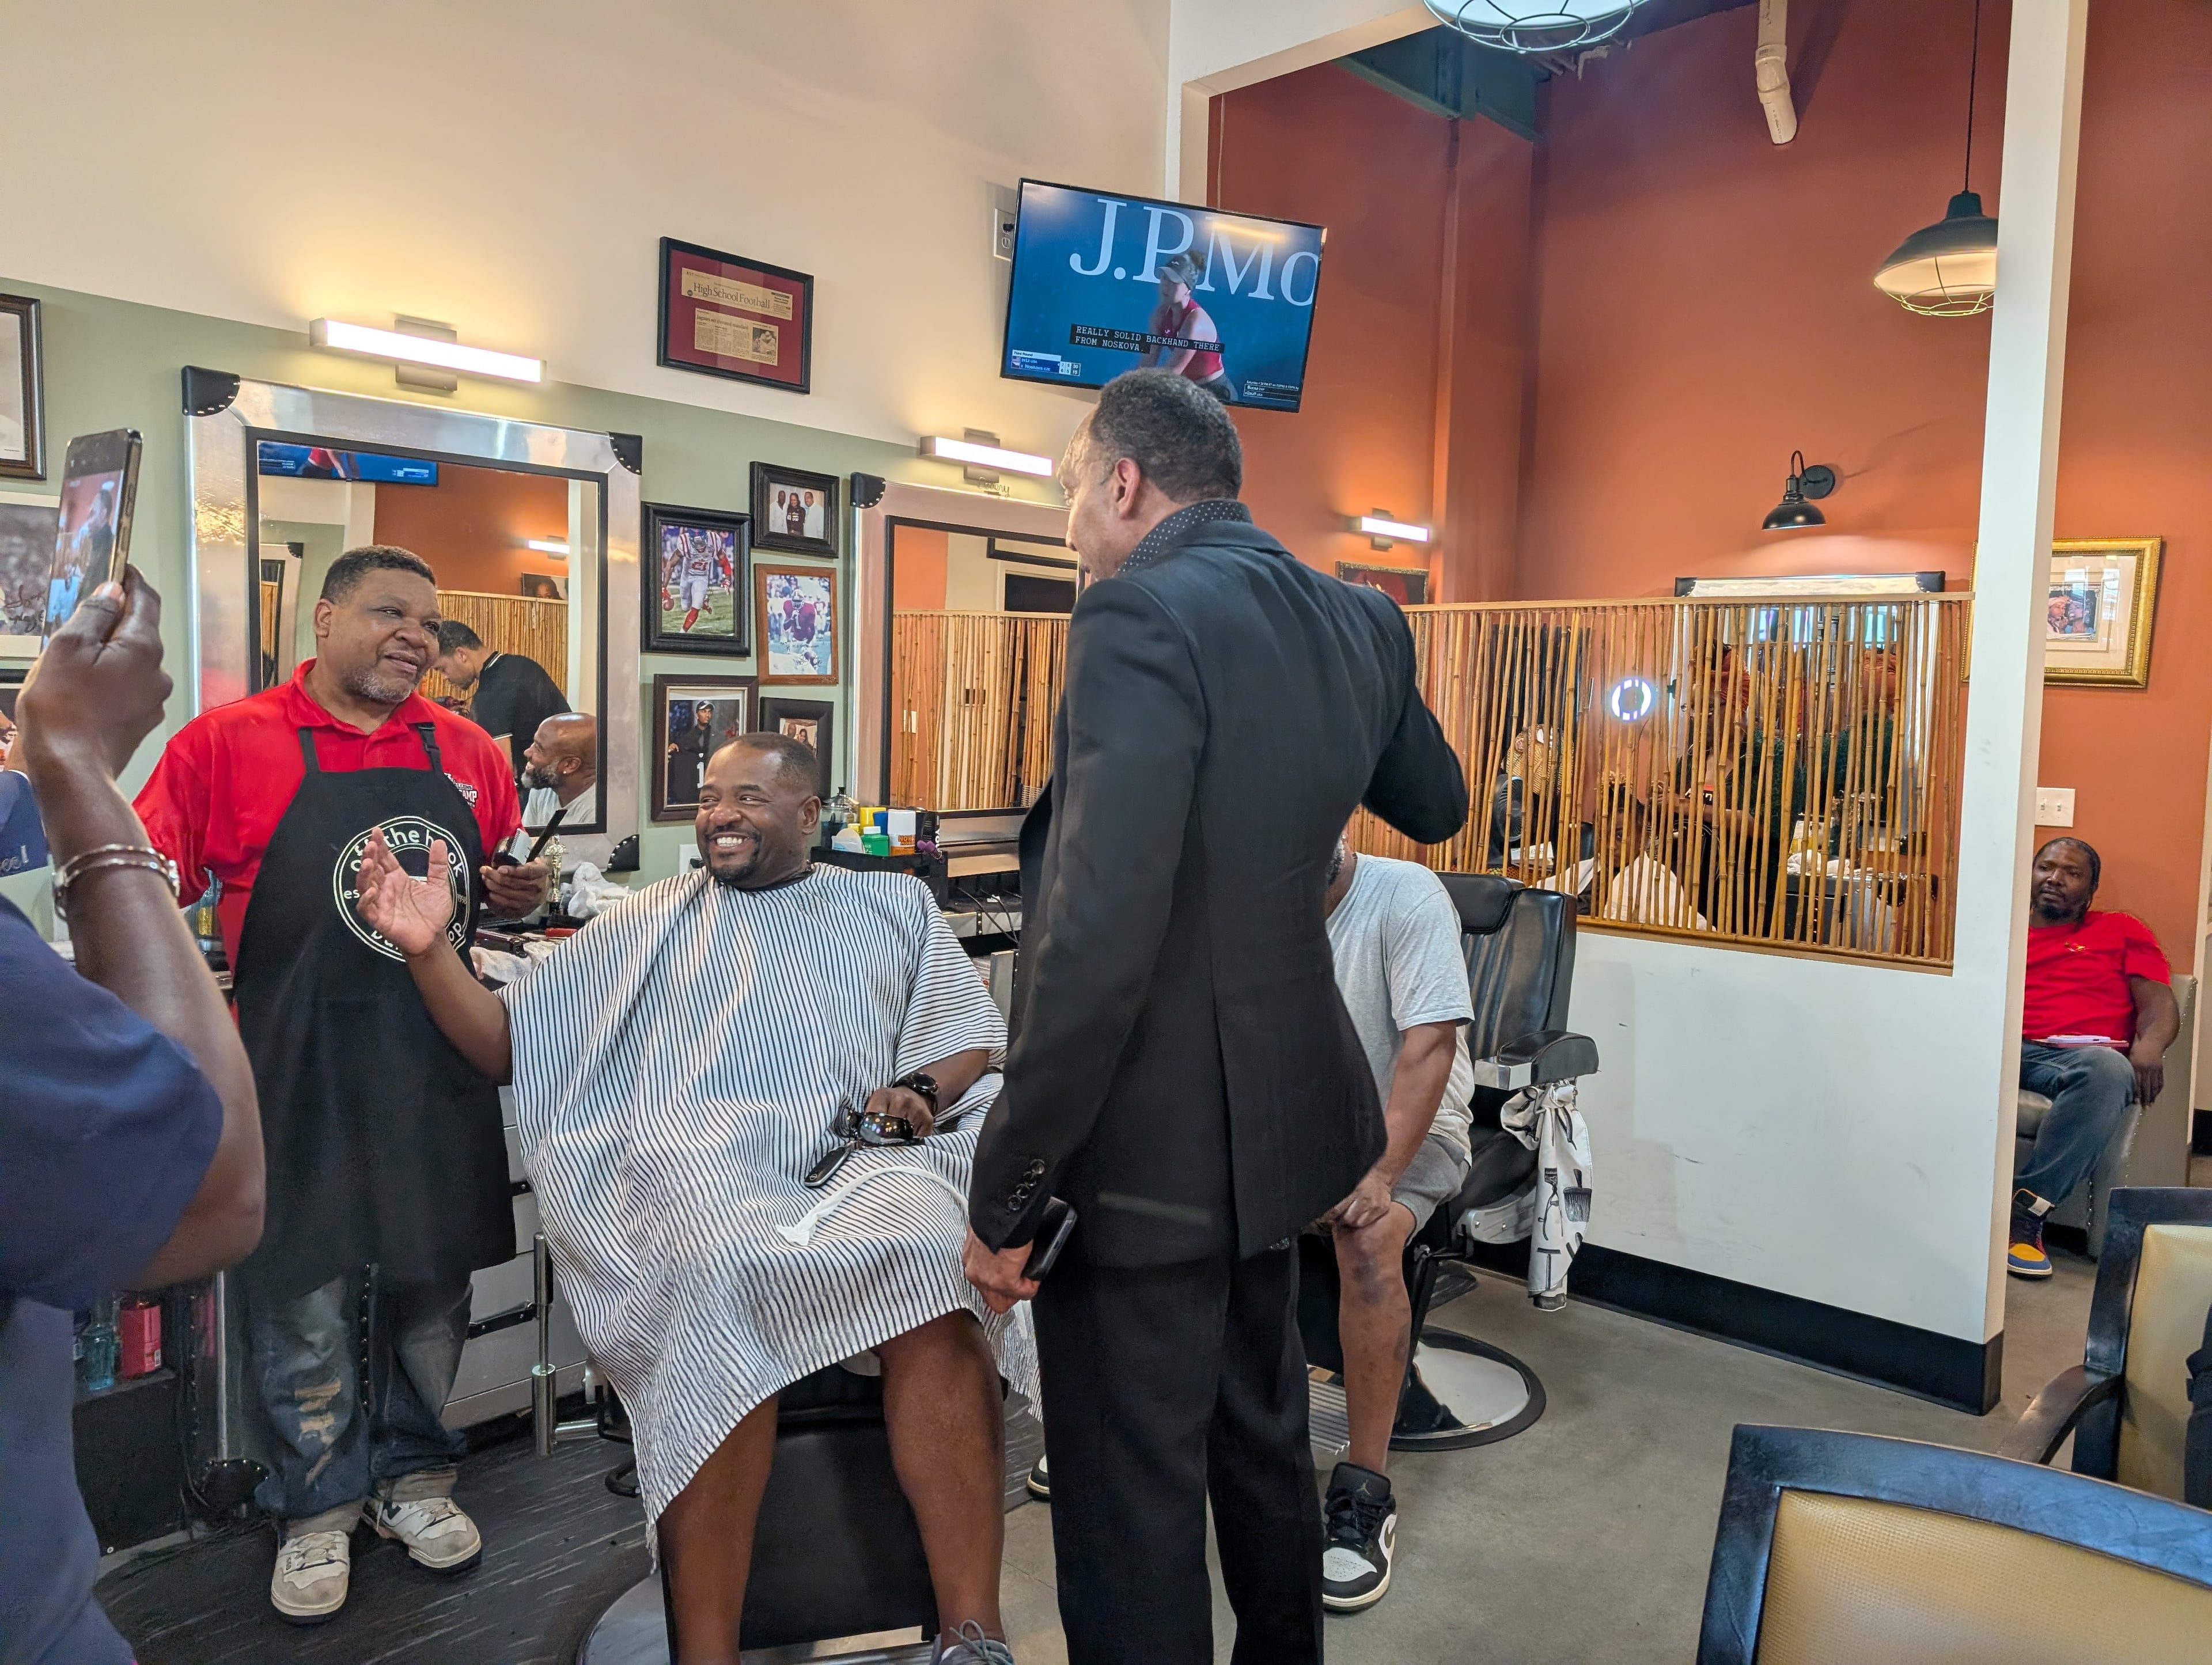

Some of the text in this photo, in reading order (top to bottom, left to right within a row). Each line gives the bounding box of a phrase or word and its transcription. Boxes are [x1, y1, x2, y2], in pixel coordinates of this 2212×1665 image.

[694, 282, 713, 297] High
[714, 287, 739, 301] School
[740, 294, 770, 309] Football
[1075, 336, 1144, 352] FROM NOSKOVA.
[1076, 326, 1220, 351] REALLY SOLID BACKHAND THERE
[383, 828, 420, 848] the
